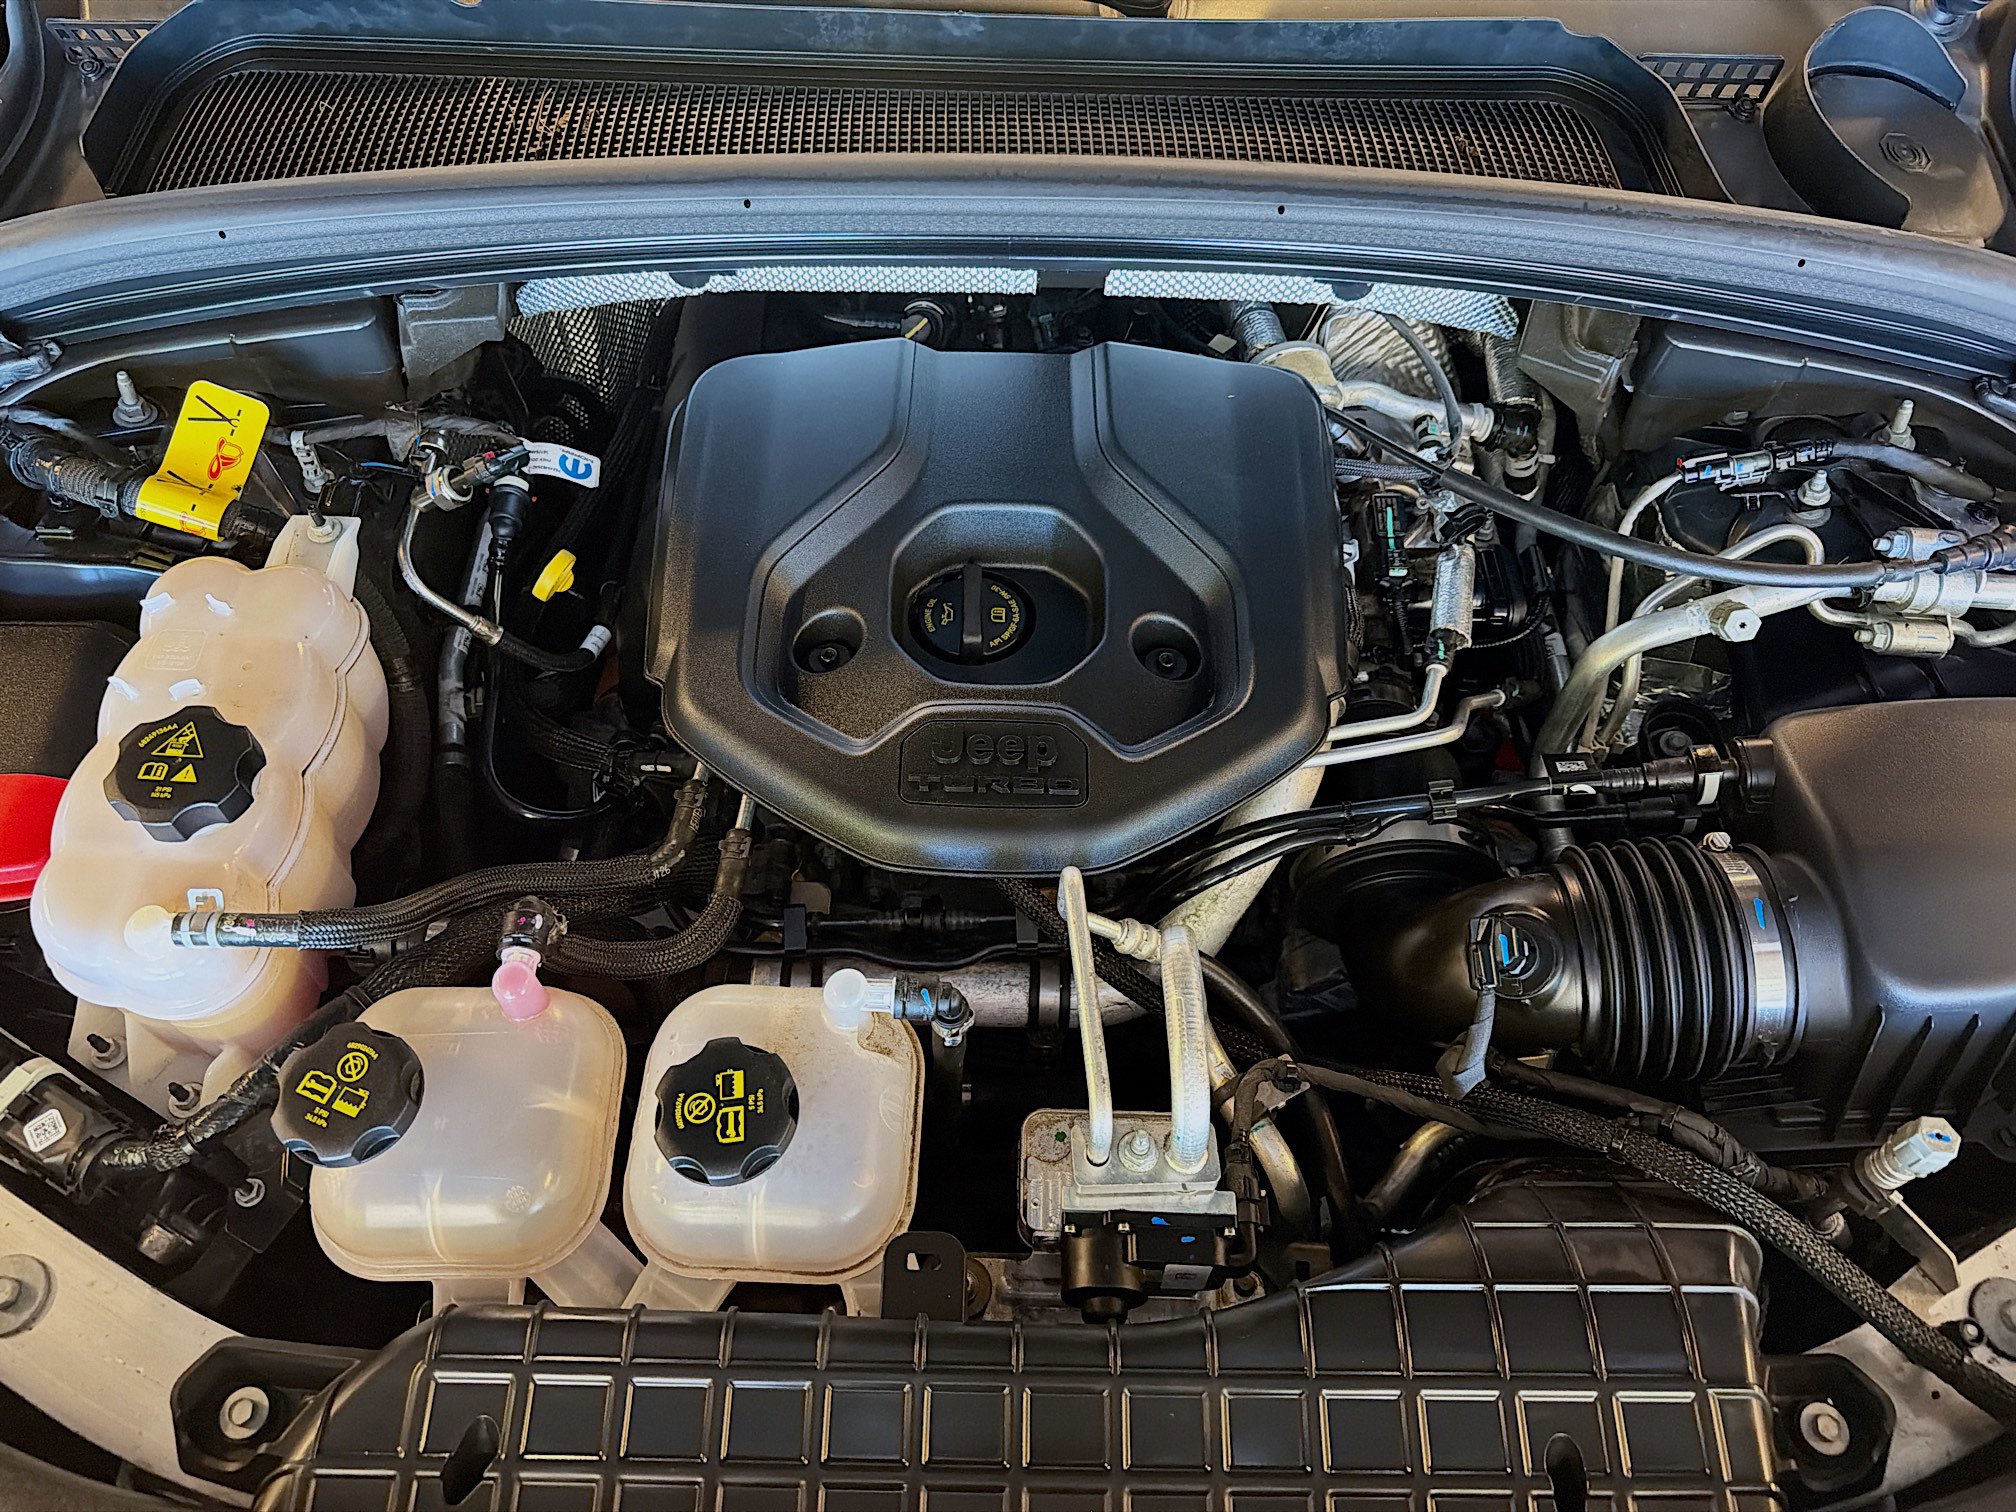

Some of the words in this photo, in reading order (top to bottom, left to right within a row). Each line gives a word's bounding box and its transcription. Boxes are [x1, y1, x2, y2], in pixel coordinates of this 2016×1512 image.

[926, 598, 938, 608] OIL
[924, 608, 936, 633] ENGINE
[989, 637, 1004, 648] API
[931, 726, 1058, 774] Jeep
[908, 774, 1080, 796] TURBO
[756, 1088, 764, 1101] kPa
[319, 1108, 330, 1117] PSI
[315, 1116, 328, 1128] kPa
